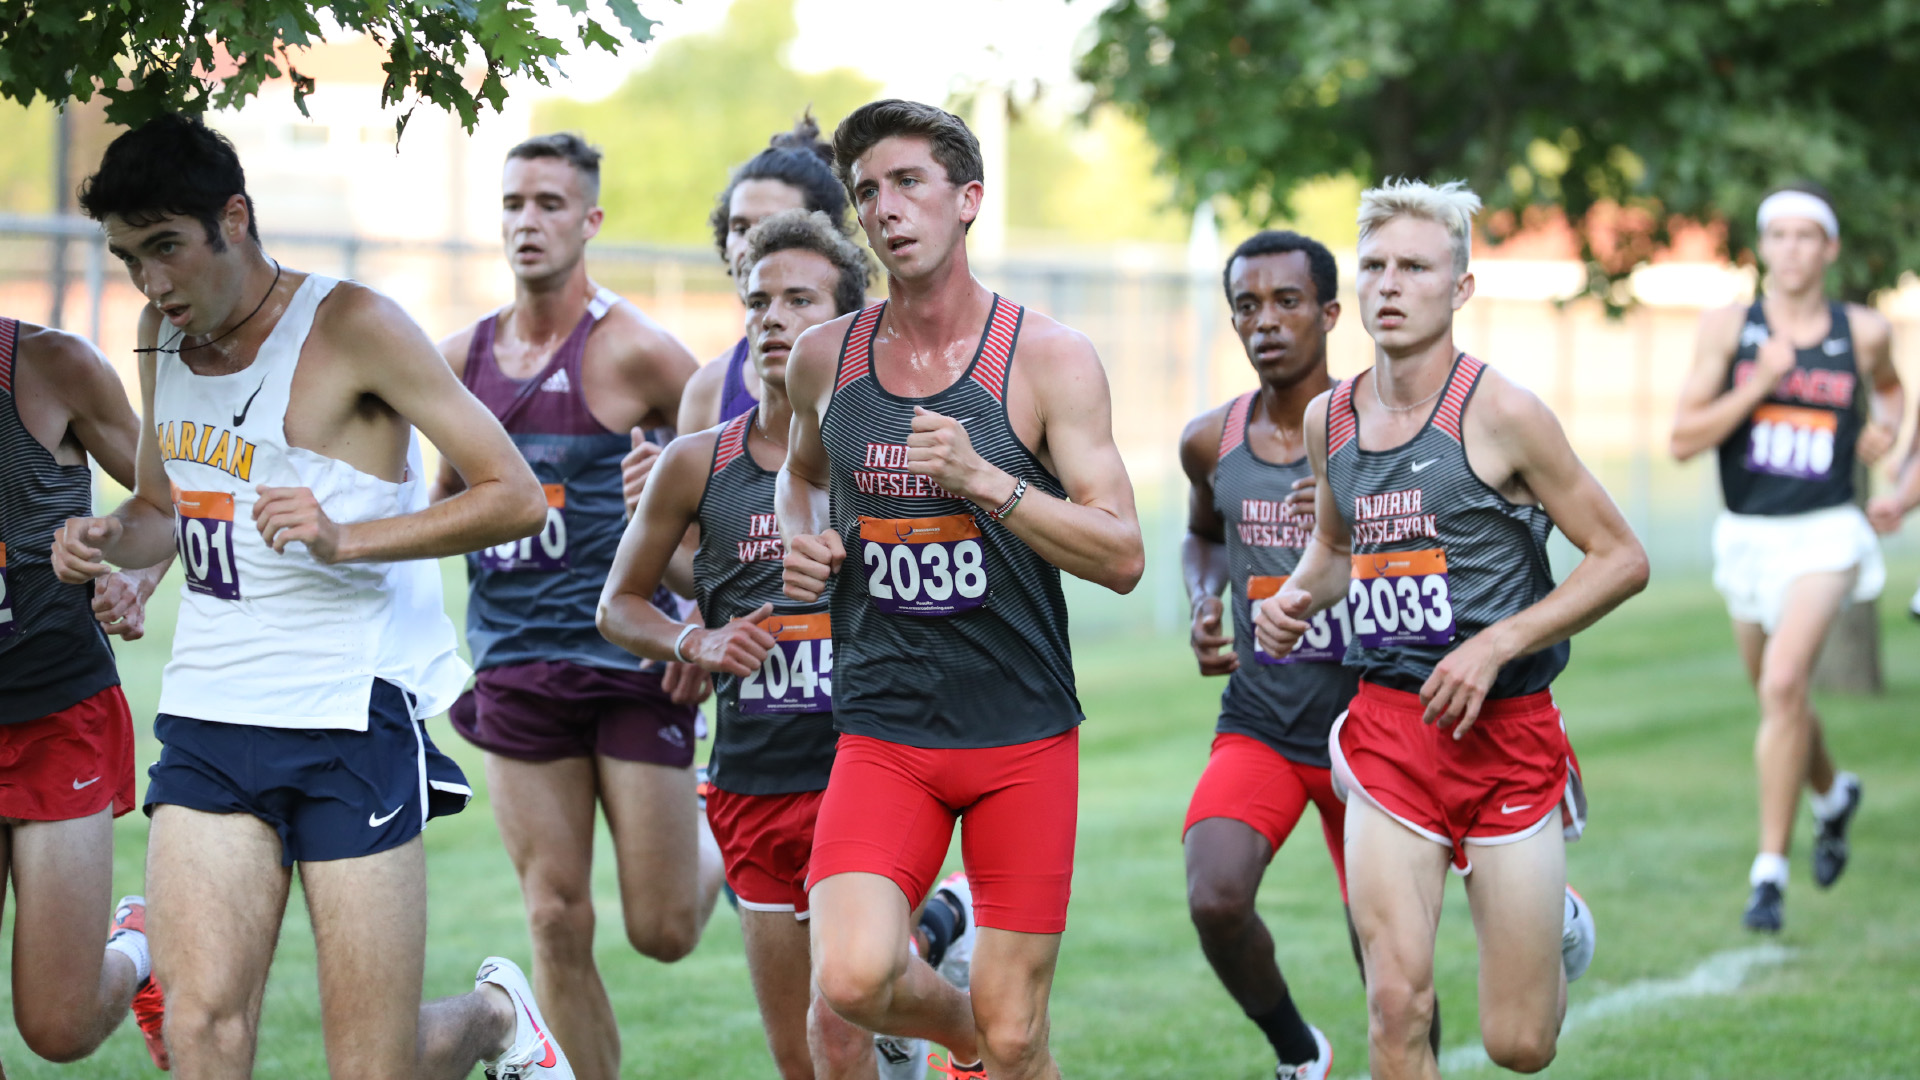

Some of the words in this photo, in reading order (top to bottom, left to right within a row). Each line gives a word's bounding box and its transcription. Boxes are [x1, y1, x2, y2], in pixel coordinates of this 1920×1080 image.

[853, 471, 966, 499] WESLEY
[1242, 499, 1315, 523] INDIA
[1355, 488, 1422, 521] INDIANA
[1353, 513, 1437, 545] WESLEYAN
[863, 539, 987, 601] 2038
[1349, 574, 1453, 634] 2033
